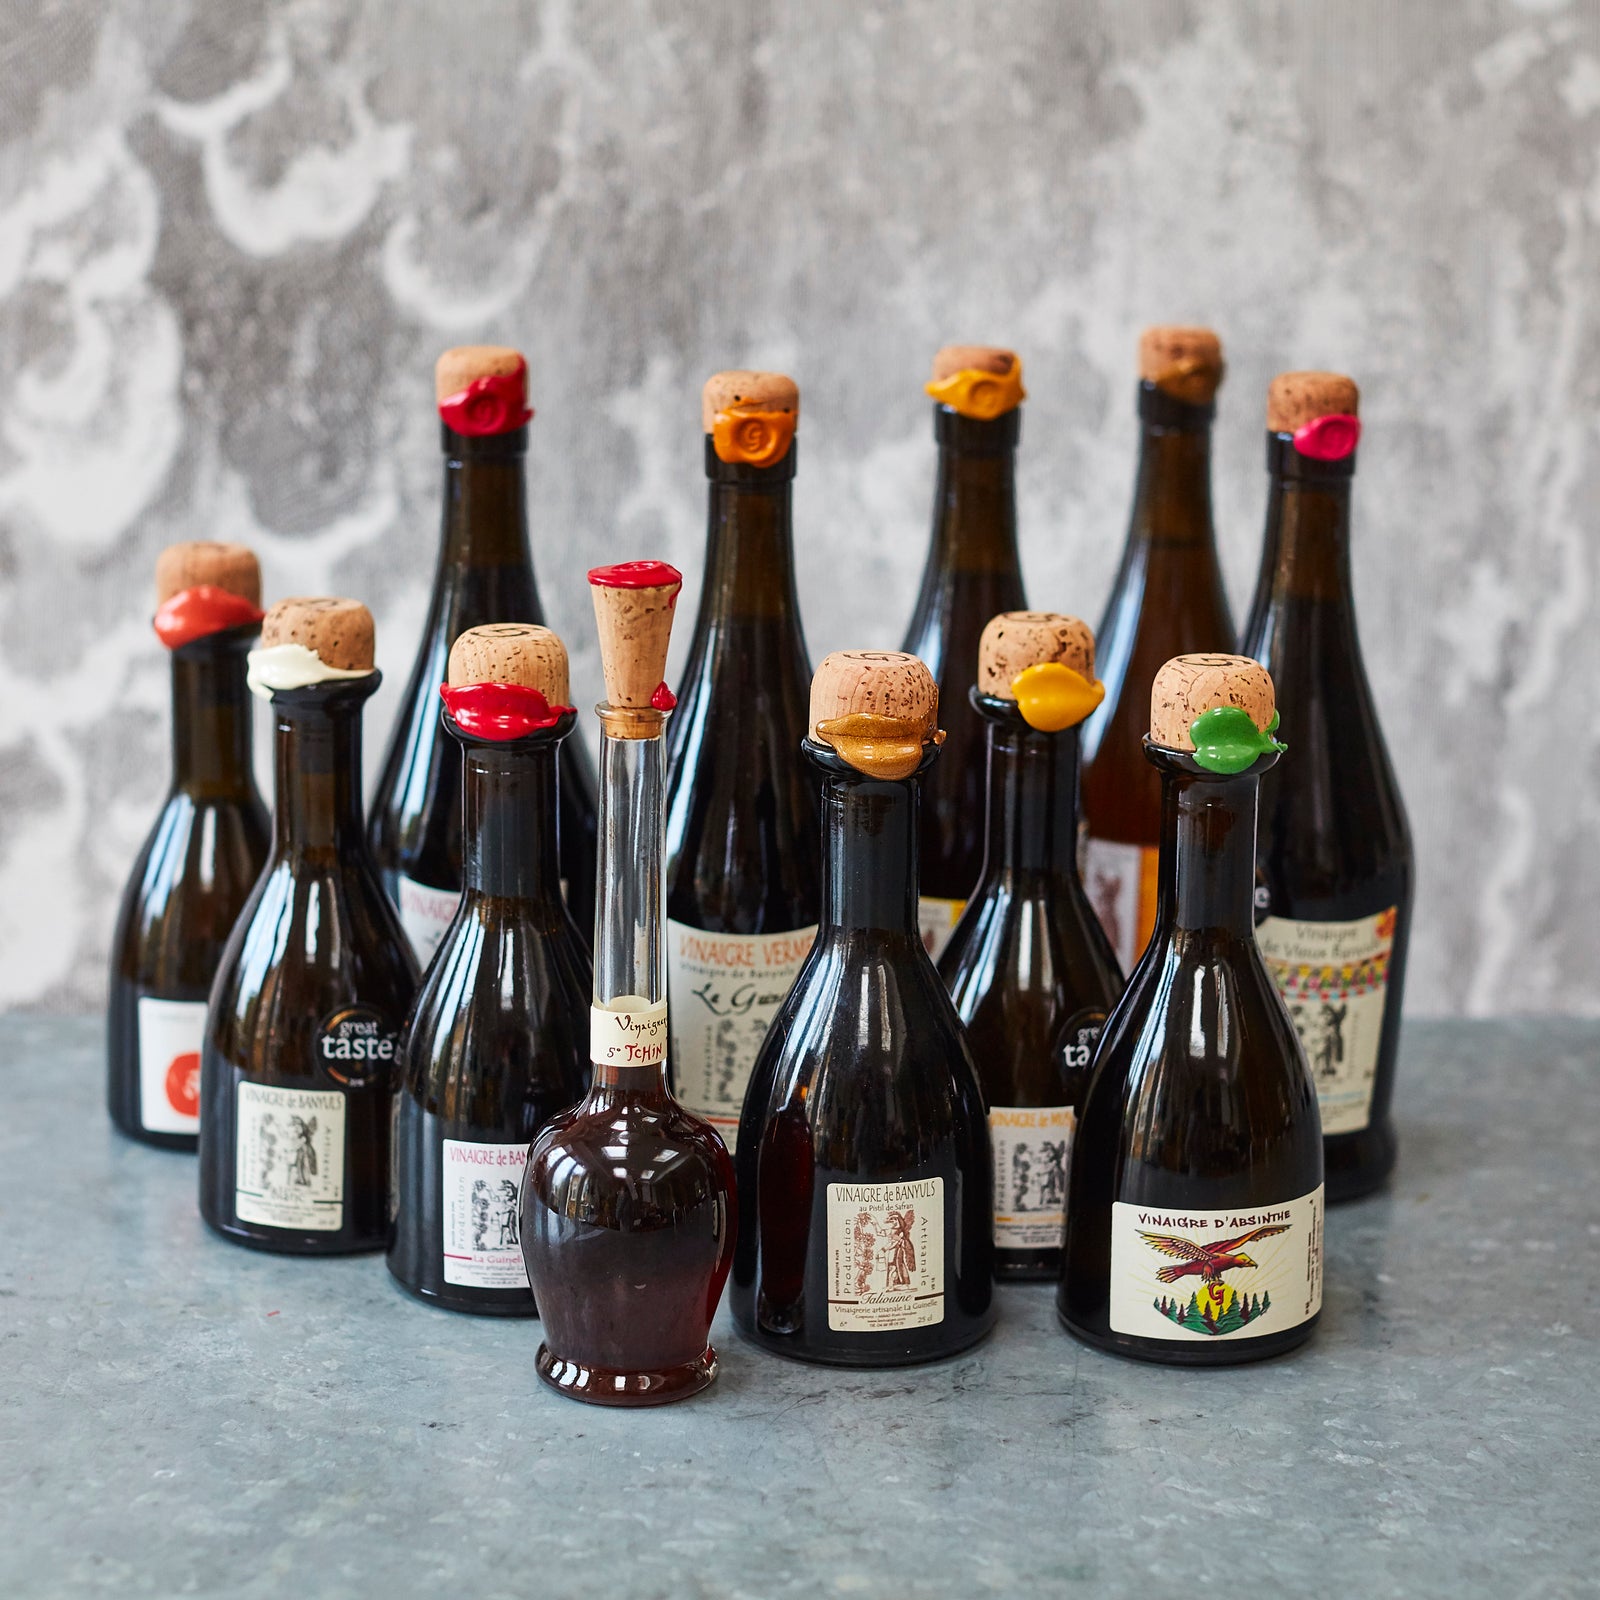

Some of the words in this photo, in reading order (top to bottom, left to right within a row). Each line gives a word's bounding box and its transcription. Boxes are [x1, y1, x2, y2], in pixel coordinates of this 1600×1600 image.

[680, 934, 755, 967] VINAIGRE
[339, 1021, 377, 1038] great
[321, 1035, 393, 1060] taste
[450, 1146, 494, 1165] VINAIGRE
[496, 1151, 507, 1166] de
[835, 1187, 882, 1203] VINAIGRE
[883, 1186, 894, 1203] de
[895, 1181, 936, 1201] BANYULS
[457, 1176, 465, 1250] Production
[869, 1203, 884, 1212] Pistil
[895, 1202, 914, 1211] Safran
[1138, 1213, 1208, 1229] VINAIGRE
[1215, 1210, 1291, 1228] D'ABSINTHE
[843, 1219, 852, 1294] Production
[920, 1216, 929, 1287] Artisanale
[1208, 1281, 1225, 1306] G
[835, 1306, 870, 1315] Vinaigrerie
[872, 1304, 903, 1313] artisanale
[904, 1303, 911, 1311] La
[913, 1299, 938, 1310] Guinelle
